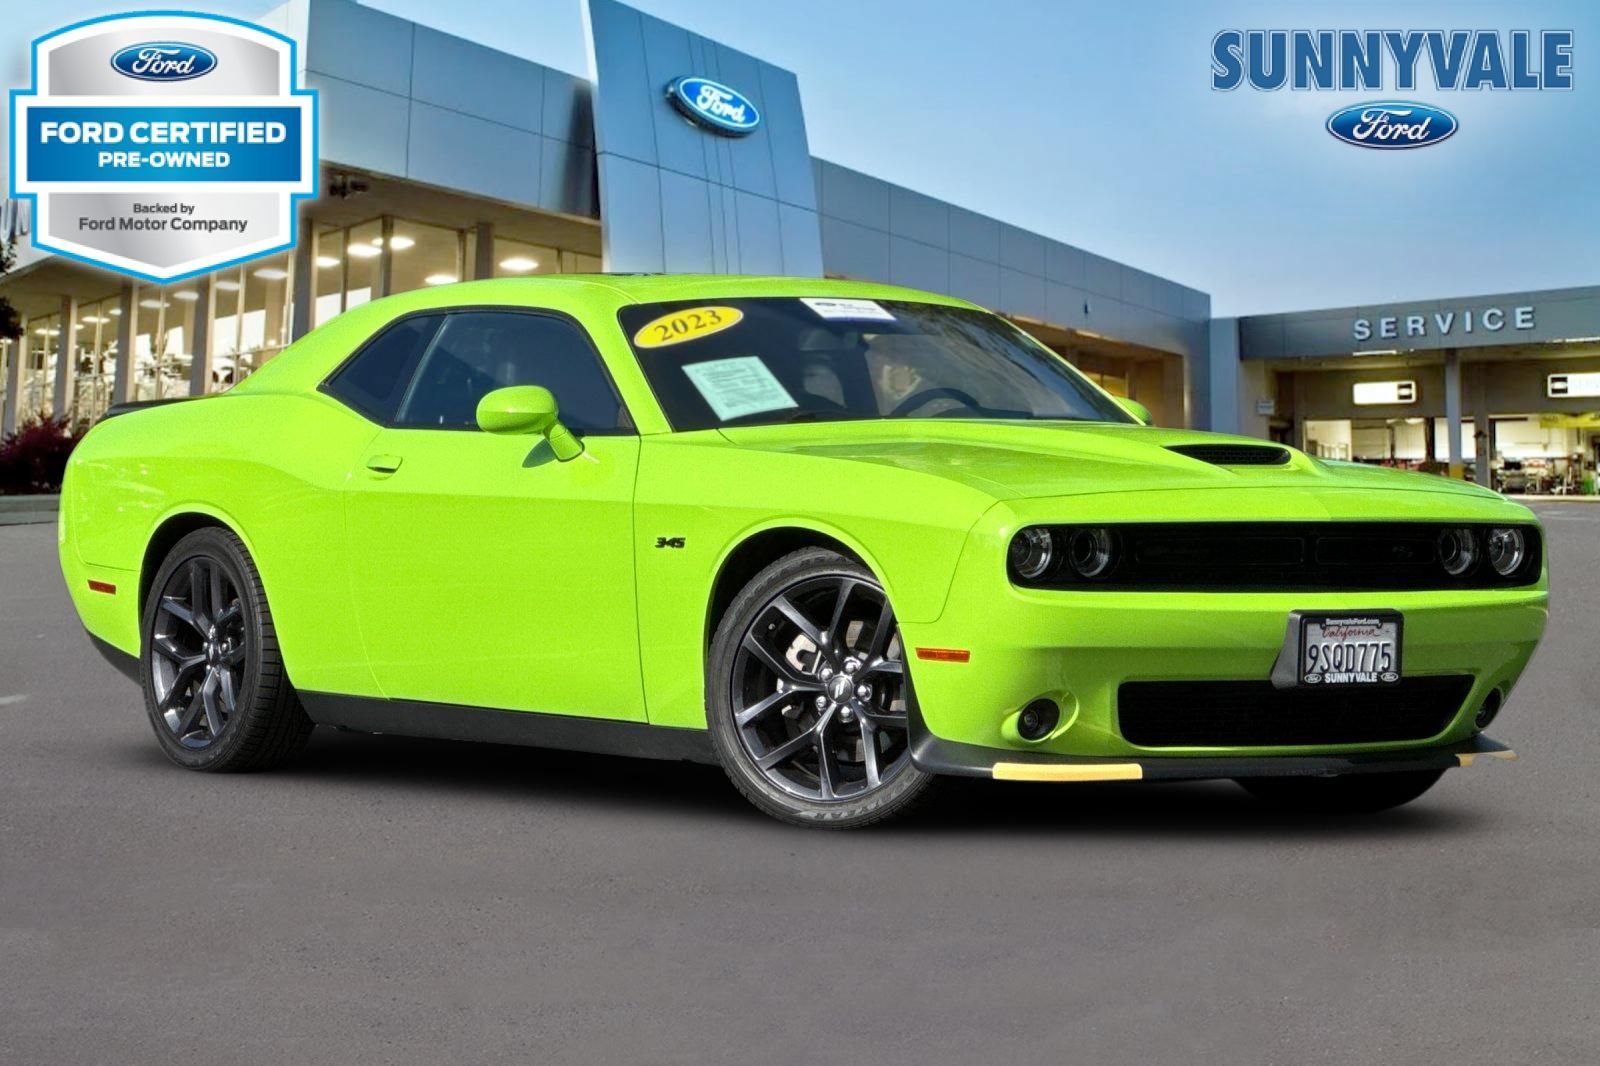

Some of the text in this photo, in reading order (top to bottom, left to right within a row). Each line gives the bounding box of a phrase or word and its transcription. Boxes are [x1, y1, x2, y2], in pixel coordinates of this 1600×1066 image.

[696, 84, 746, 123] Ford
[653, 308, 723, 342] 2023
[1353, 306, 1536, 341] SERVICE
[1322, 626, 1379, 641] California
[1308, 643, 1391, 673] 9SQD775
[1325, 672, 1377, 683] SUNNYVALE
